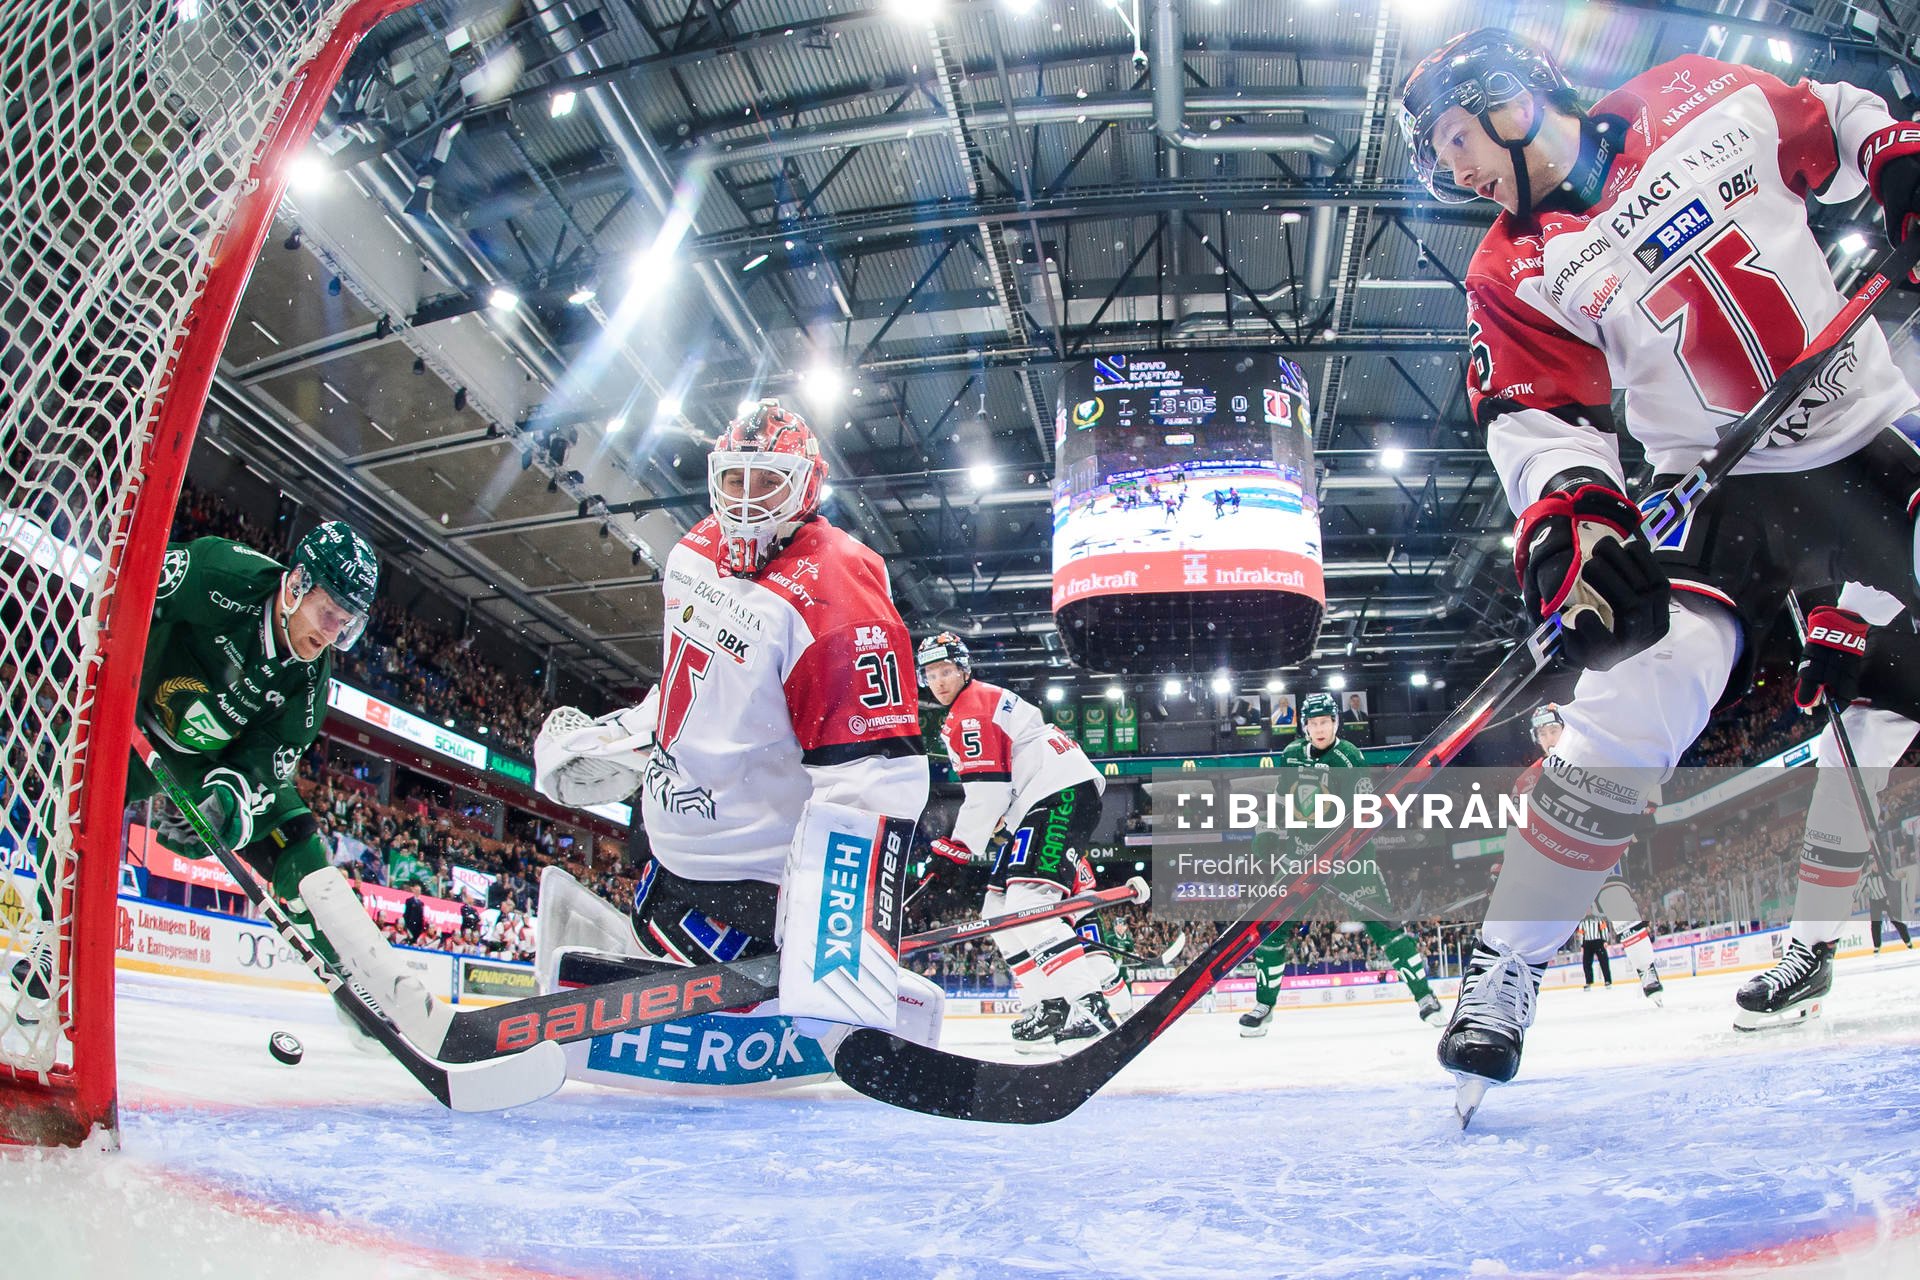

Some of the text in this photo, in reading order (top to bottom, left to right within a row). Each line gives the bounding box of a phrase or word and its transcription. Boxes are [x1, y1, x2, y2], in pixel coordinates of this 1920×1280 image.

[1662, 91, 1708, 127] NÄRKE
[1706, 72, 1741, 101] KÖTT
[1683, 126, 1751, 170] NASTA
[1706, 146, 1745, 171] INTERIÖR
[1718, 164, 1758, 203] OBK
[1611, 171, 1680, 239] EXACT
[1656, 206, 1708, 248] BRL
[1510, 254, 1544, 280] NÄRK
[1551, 236, 1612, 304] INFRA-CON
[1580, 273, 1620, 320] Radiator
[1130, 361, 1166, 371] NOVO
[1149, 396, 1217, 416] 18:05
[731, 536, 758, 573] 31
[766, 571, 815, 608] NÄRKE KÖTT
[1215, 567, 1305, 588] Infrakraft
[694, 581, 725, 607] EXACT
[726, 598, 761, 631] NASTA
[717, 629, 750, 658] OBK
[854, 651, 903, 709] 31
[183, 727, 213, 745] BK
[189, 712, 215, 730] F
[962, 730, 982, 758] 5
[1596, 777, 1640, 800] CENTER
[1540, 793, 1604, 836] STILL
[931, 840, 972, 861] BAUER
[1536, 833, 1590, 862] BAUER
[877, 831, 901, 932] BAUER
[823, 842, 862, 961] HEROK
[138, 909, 211, 941] Lärkängens Bygg
[957, 919, 990, 934] MACH
[138, 940, 145, 953] &
[147, 937, 197, 960] Entreprenad
[258, 897, 344, 993] CCM
[469, 969, 536, 988] FINNFORM
[497, 974, 722, 1052] BAUER
[610, 1019, 804, 1074] HEROK
